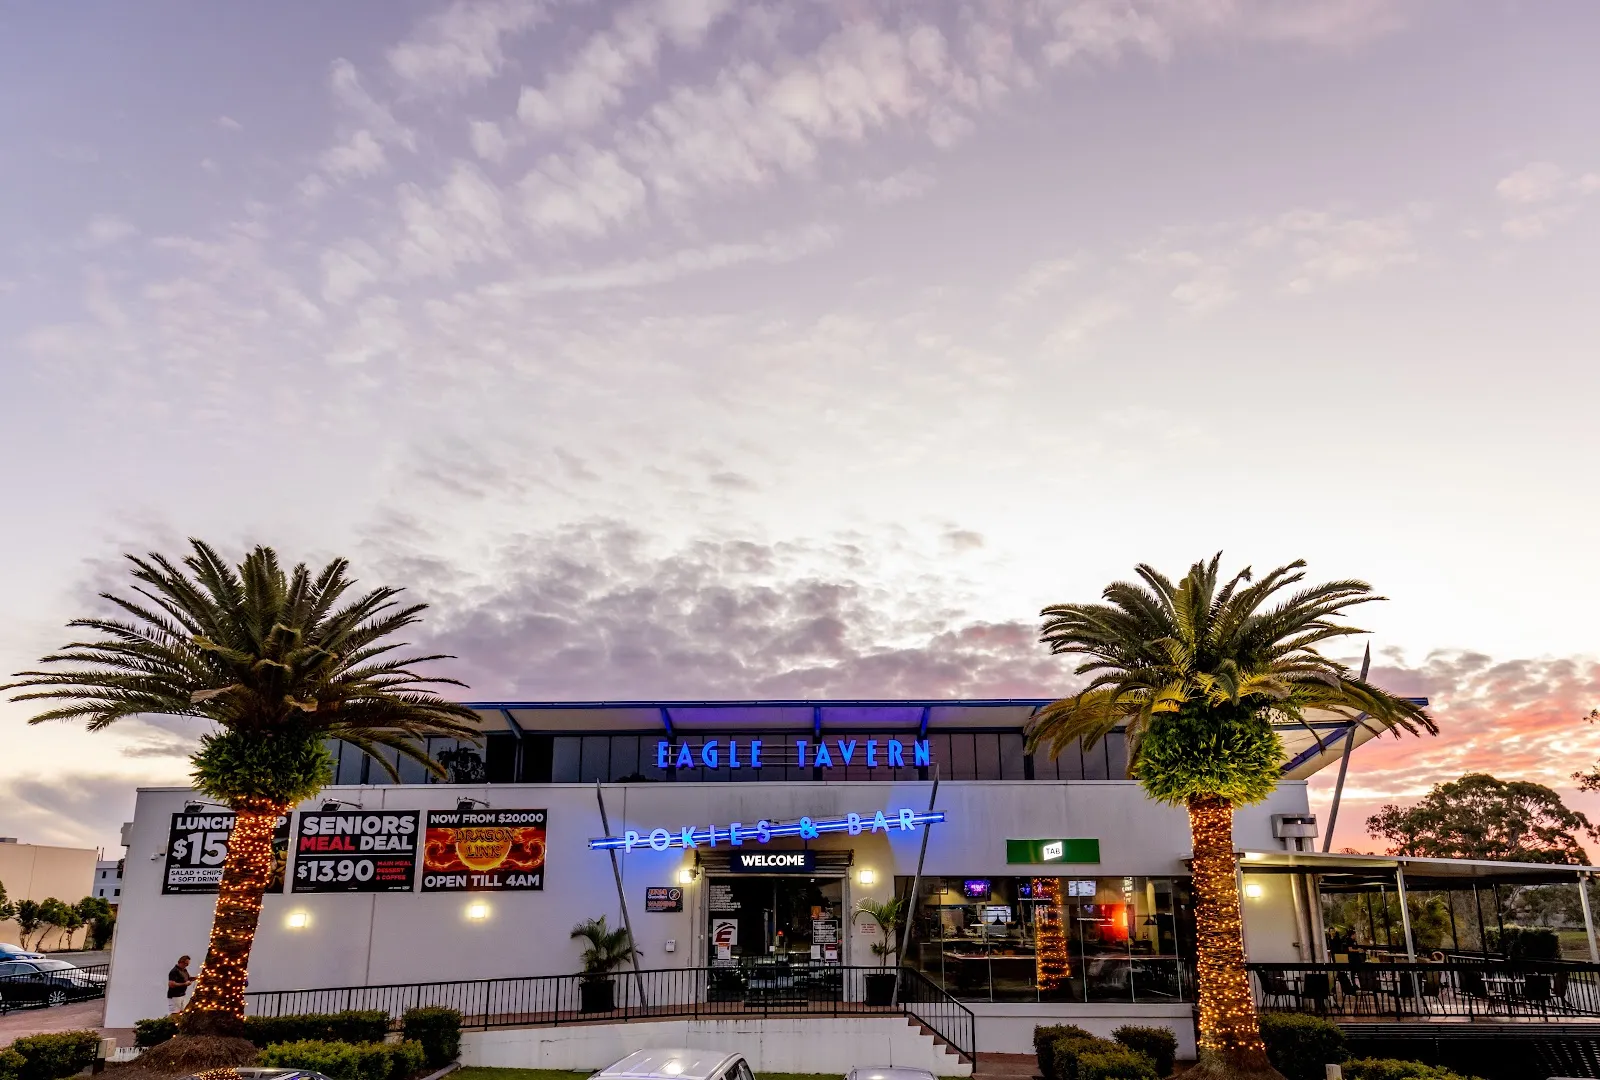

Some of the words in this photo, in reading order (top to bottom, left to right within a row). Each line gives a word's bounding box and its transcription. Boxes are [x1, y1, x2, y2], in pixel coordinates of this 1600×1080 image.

[657, 740, 762, 769] EAGLE
[796, 739, 931, 769] TAVERN
[176, 816, 235, 830] LUNCH
[301, 815, 416, 836] SENIORS
[430, 814, 460, 824] NOW
[462, 813, 496, 823] FROM
[498, 813, 544, 824] $20,000
[454, 828, 515, 843] DRAGON
[624, 820, 771, 853] POKIES
[799, 816, 820, 840] &
[847, 808, 916, 837] BAR
[171, 831, 229, 866] $15
[299, 836, 356, 851] MEAL
[359, 835, 413, 851] DEAL
[466, 844, 502, 859] LINK
[1046, 847, 1061, 855] TAB
[741, 854, 805, 867] WELCOME
[297, 859, 375, 882] $13.90
[424, 875, 467, 888] OPEN
[471, 874, 503, 887] TILL
[505, 874, 540, 886] 4AM
